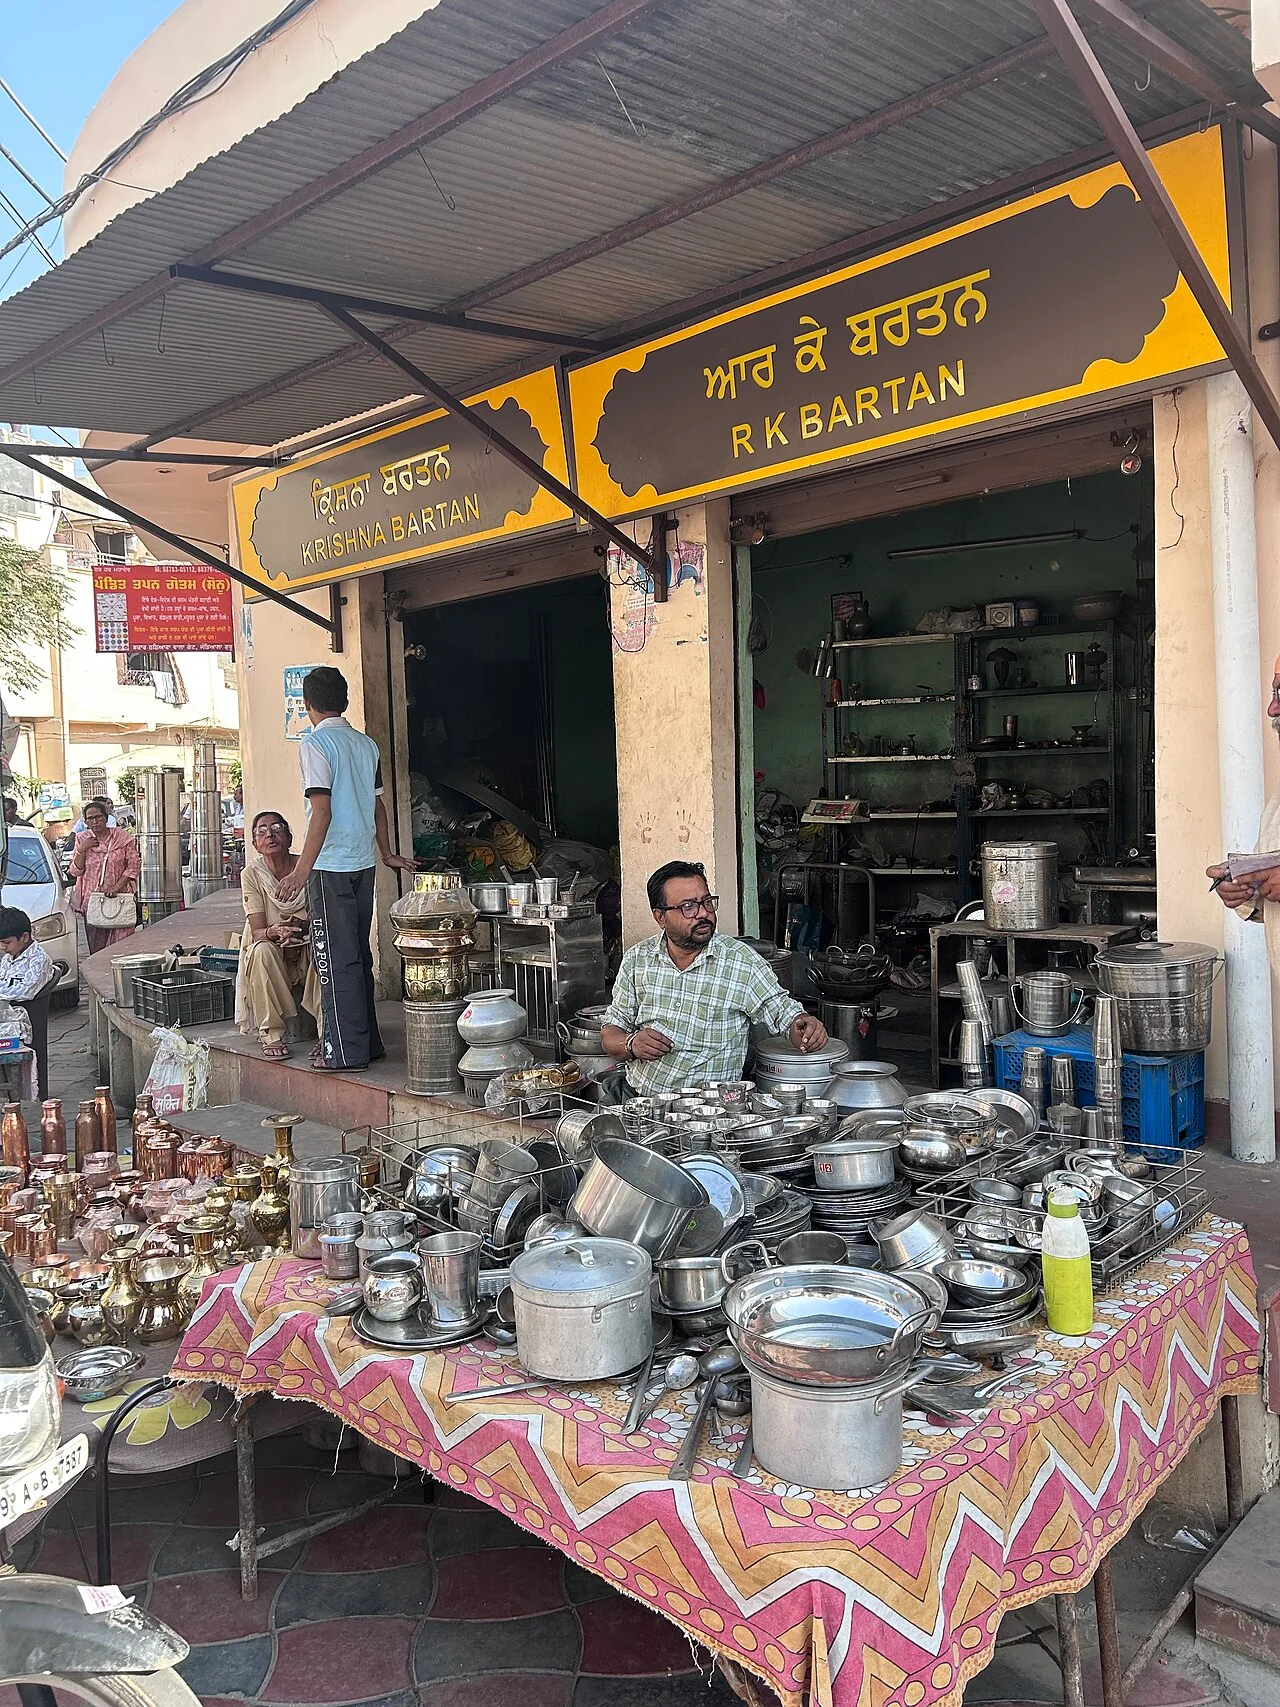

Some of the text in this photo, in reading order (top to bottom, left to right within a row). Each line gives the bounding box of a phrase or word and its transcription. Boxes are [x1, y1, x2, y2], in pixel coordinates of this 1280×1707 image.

[703, 268, 991, 400] ਆਰ ਕੇ ਬਰਤਨ
[731, 359, 966, 459] R K BARTAN
[379, 444, 451, 497] ਬਰਤਨ
[300, 493, 480, 566] KRISHNA BARTAN
[94, 576, 126, 591] ਪੰਡਿਤ
[132, 579, 160, 590] ਤਪਨ
[316, 951, 330, 985] POLO
[155, 1093, 181, 1117] मुक्ति
